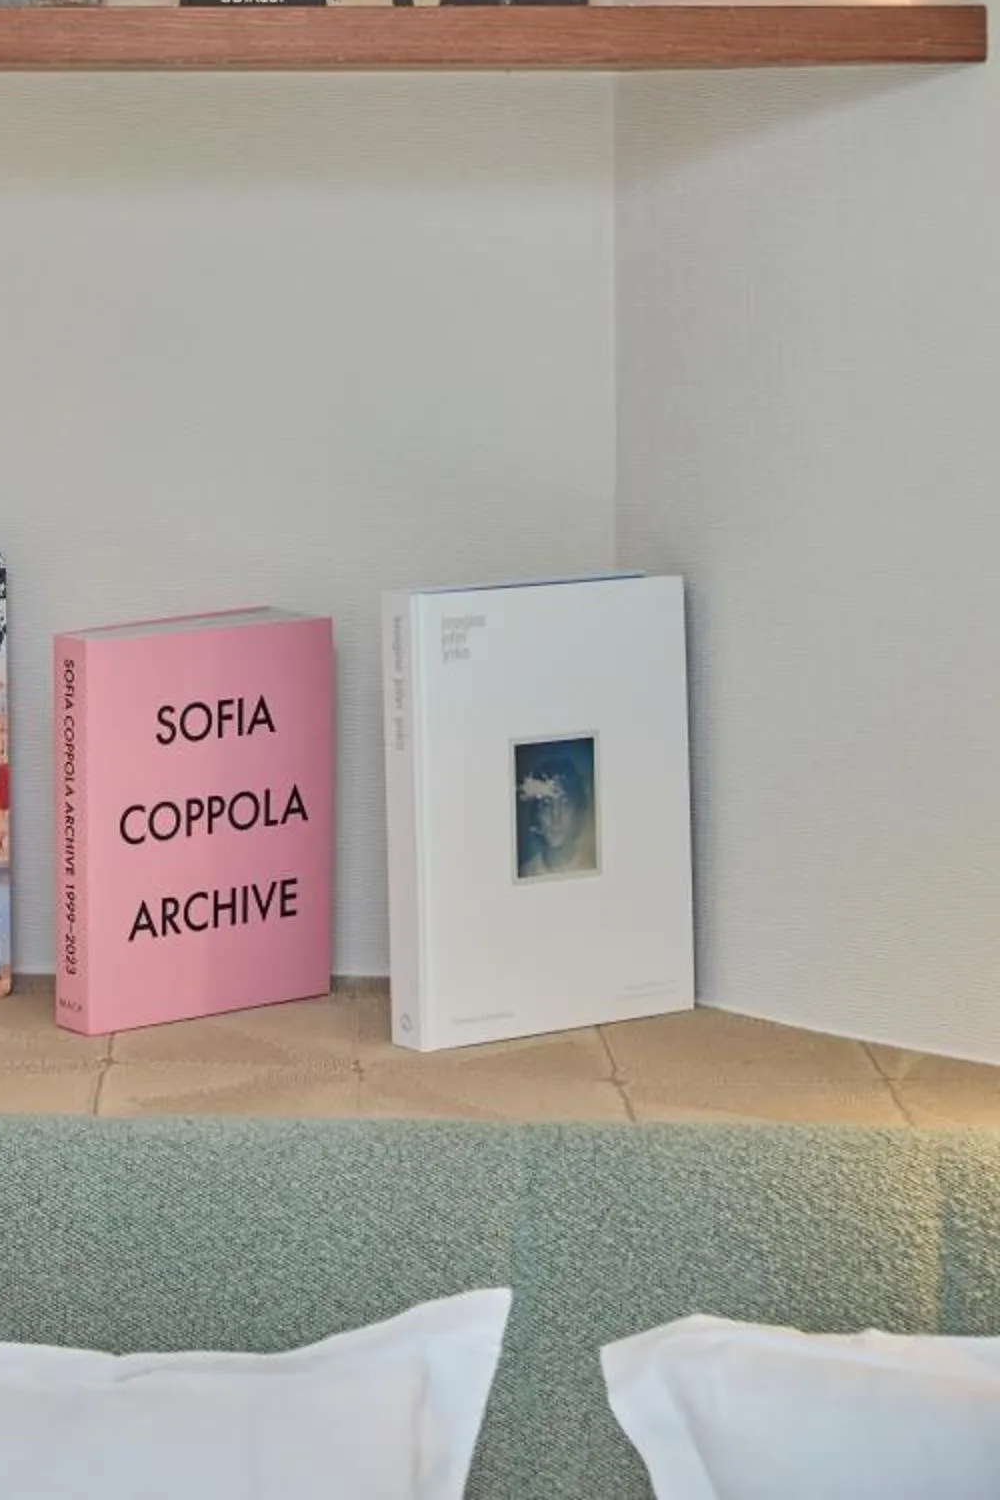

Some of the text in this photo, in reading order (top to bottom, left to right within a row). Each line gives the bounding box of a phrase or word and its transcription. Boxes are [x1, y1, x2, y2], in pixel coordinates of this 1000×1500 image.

[63, 659, 75, 710] SOFIA
[155, 695, 276, 745] SOFIA
[63, 715, 76, 797] COPPOLA
[64, 801, 76, 877] ARCHIVE
[119, 784, 309, 845] COPPOLA
[128, 878, 298, 942] ARCHIVE
